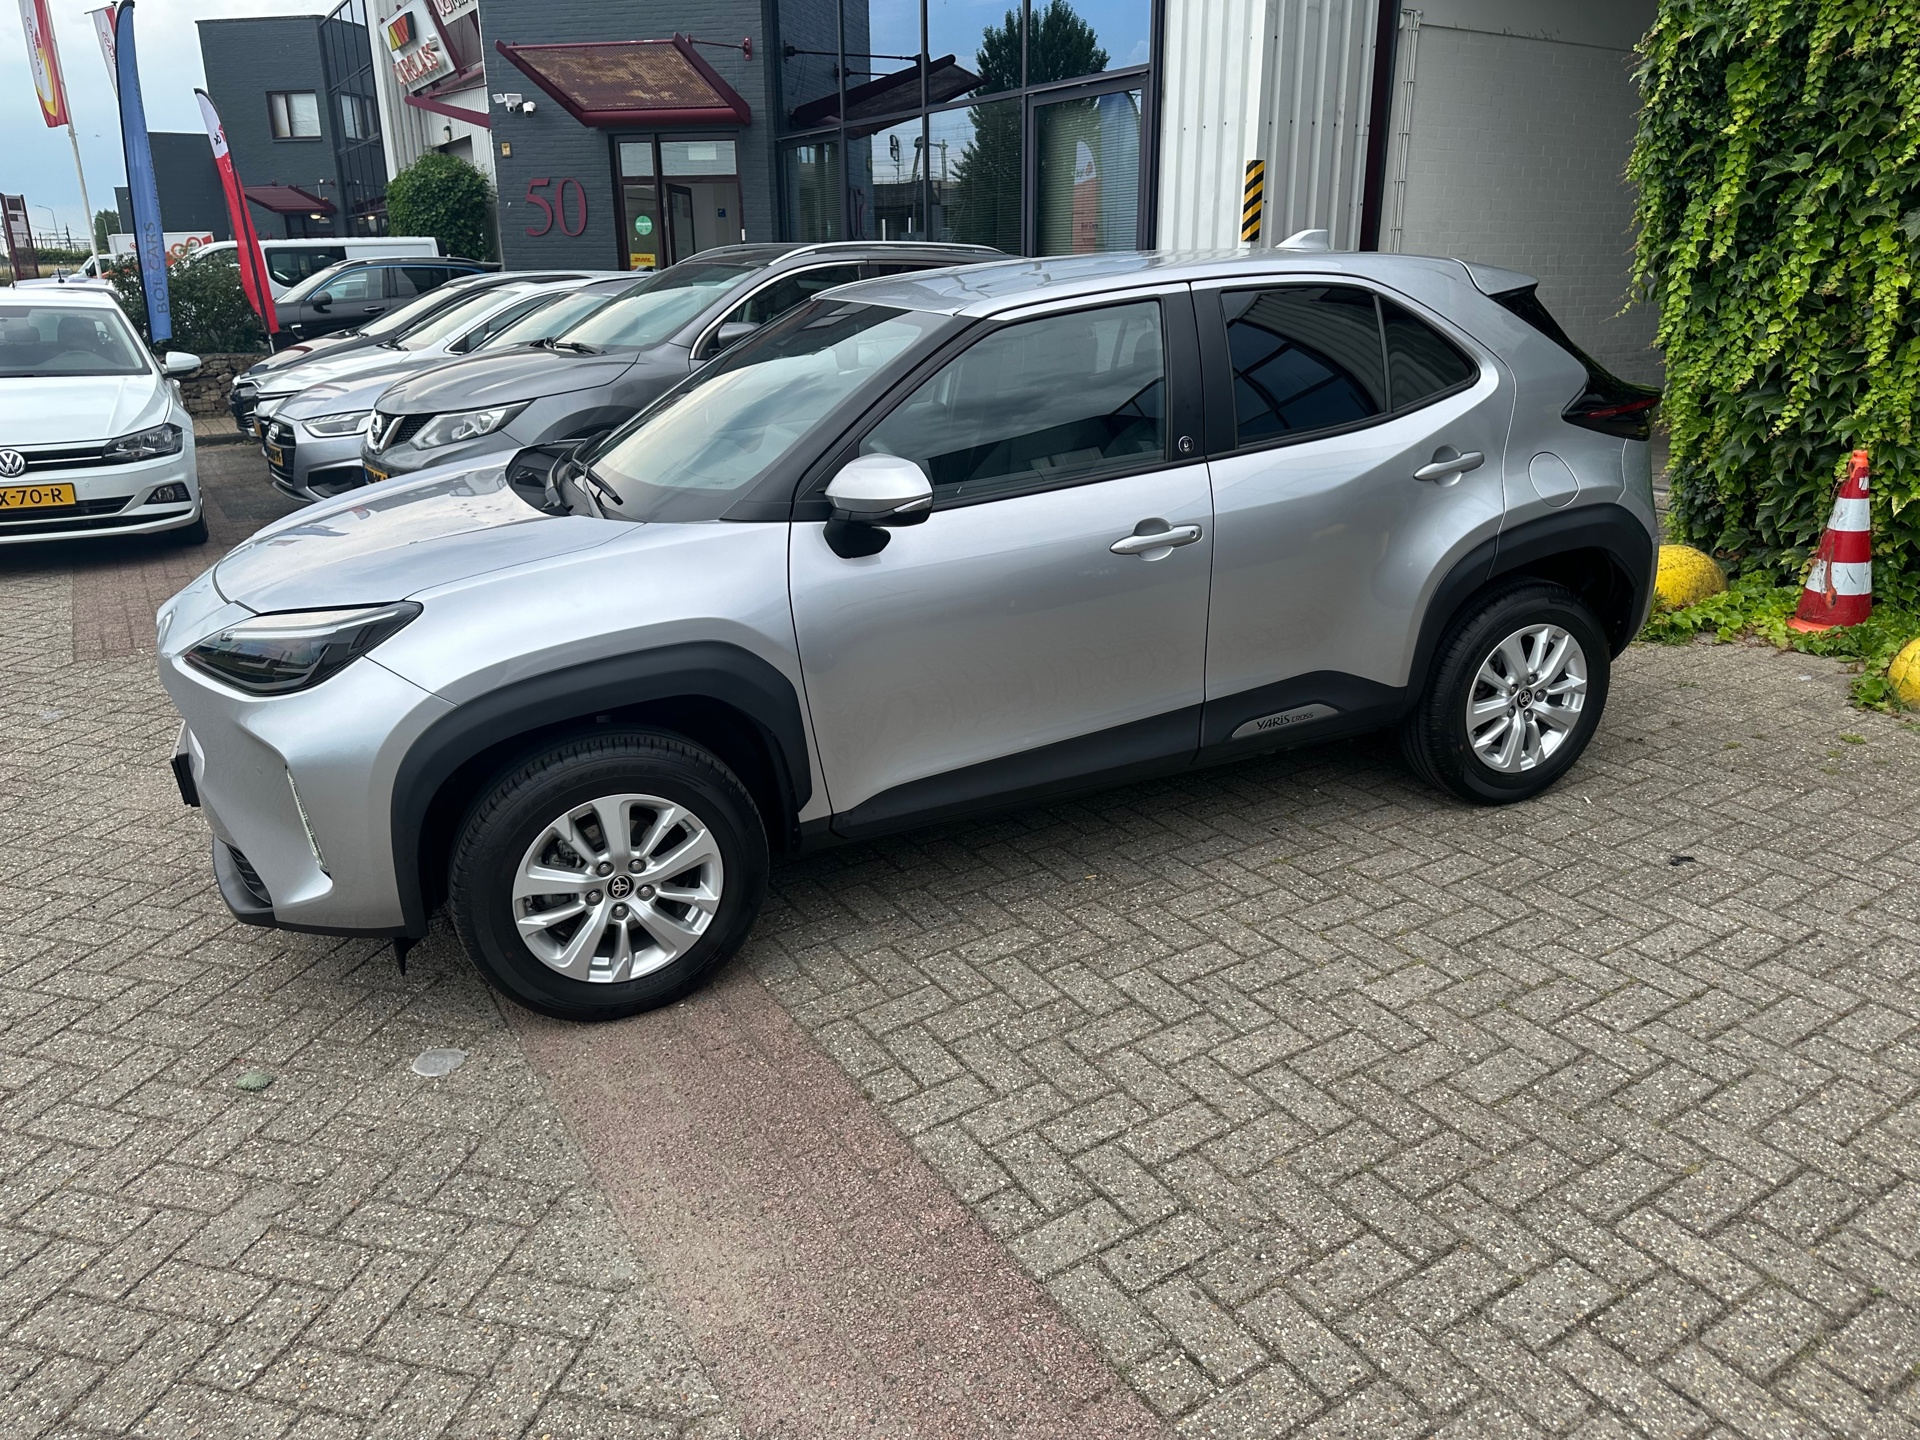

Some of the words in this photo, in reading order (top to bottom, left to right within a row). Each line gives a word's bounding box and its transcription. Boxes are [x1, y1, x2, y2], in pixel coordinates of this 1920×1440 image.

[392, 42, 439, 86] CARGLASS
[525, 176, 588, 237] 50
[143, 221, 160, 271] CARS
[153, 279, 168, 314] BOL
[0, 488, 64, 506] X-70-R
[1291, 711, 1314, 723] CROSS
